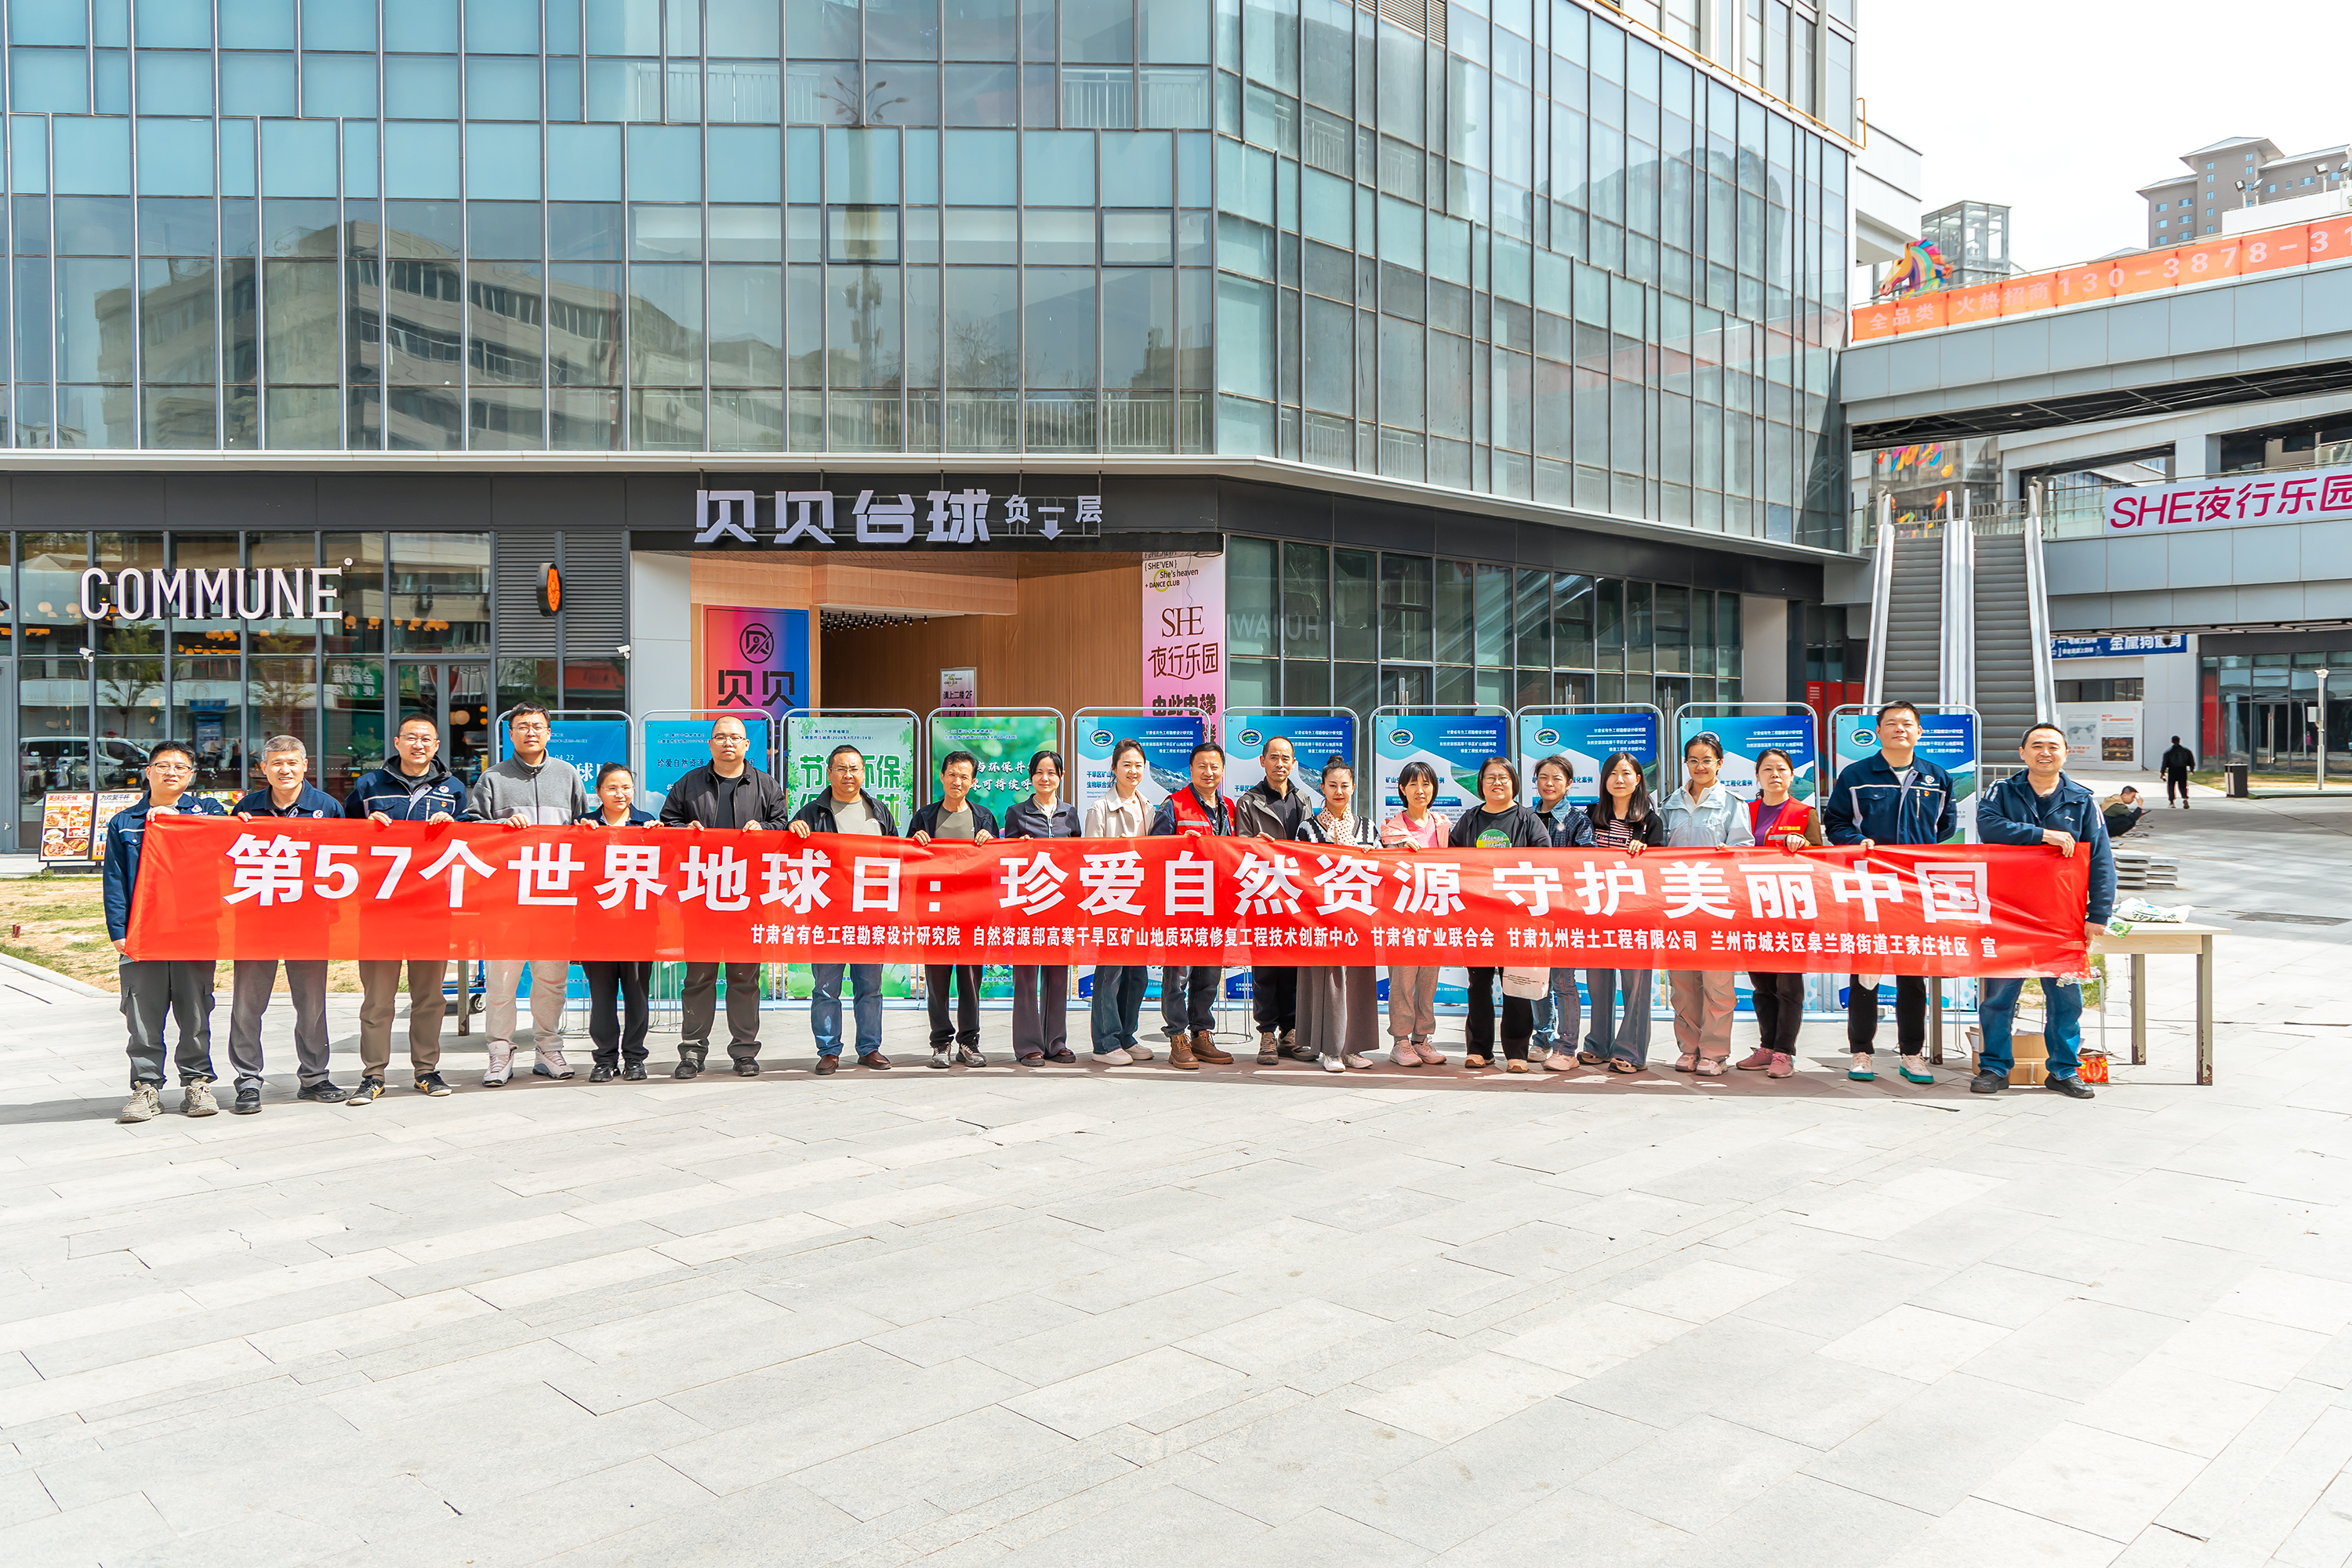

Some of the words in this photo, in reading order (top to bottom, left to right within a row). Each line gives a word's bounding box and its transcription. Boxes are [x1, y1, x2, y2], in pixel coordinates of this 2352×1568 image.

[1869, 302, 1935, 331] 全品类
[695, 488, 991, 544] 贝贝台球
[1004, 495, 1103, 524] 负一层
[81, 566, 343, 620] COMMUNE
[1161, 606, 1205, 638] SHE
[1147, 642, 1218, 681] 夜行乐园
[717, 670, 796, 706] 贝贝
[657, 758, 704, 768] 珍爱自然资源
[799, 754, 901, 789] 节保
[977, 760, 1030, 774] 与环保并
[1493, 860, 1993, 925] 守护美丽中国
[750, 924, 961, 946] 甘肃省有色工程勘察设计研究院
[973, 925, 1359, 948] 自然资源部高寒干旱区矿山地质环境修复工程技术创新中心
[1371, 927, 1495, 948] 甘肃省矿业联合会
[1507, 927, 1697, 951] 甘肃九州岩土工程有限公司
[1710, 930, 1970, 957] 兰州市城关区皋兰路街道王家庄社区
[1981, 936, 1998, 958] 宣
